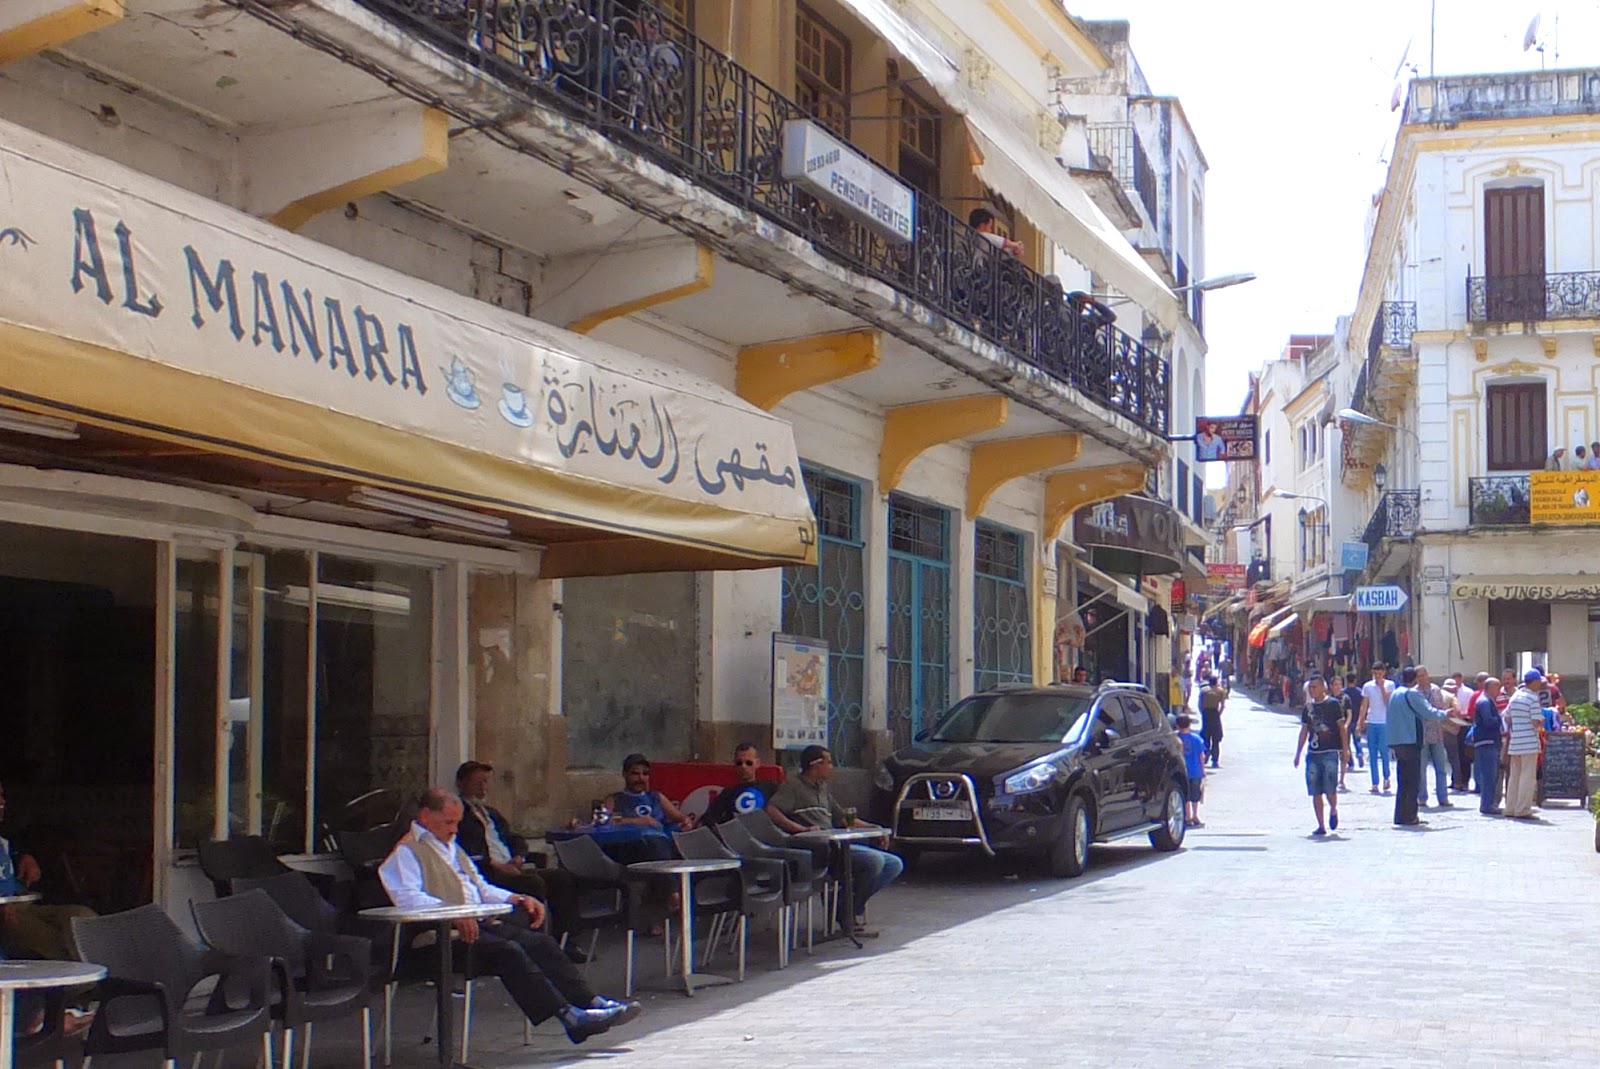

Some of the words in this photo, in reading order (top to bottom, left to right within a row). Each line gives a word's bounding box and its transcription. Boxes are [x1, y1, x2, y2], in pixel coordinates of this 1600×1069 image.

[830, 171, 870, 210] PENSION
[871, 196, 909, 235] FUENTES
[70, 207, 163, 318] AL
[183, 245, 428, 395] MANARA
[695, 432, 797, 495] مقهى
[1358, 590, 1398, 606] KASBAH
[1456, 585, 1497, 599] Café
[1504, 585, 1552, 598] TINGIS
[735, 791, 757, 814] G
